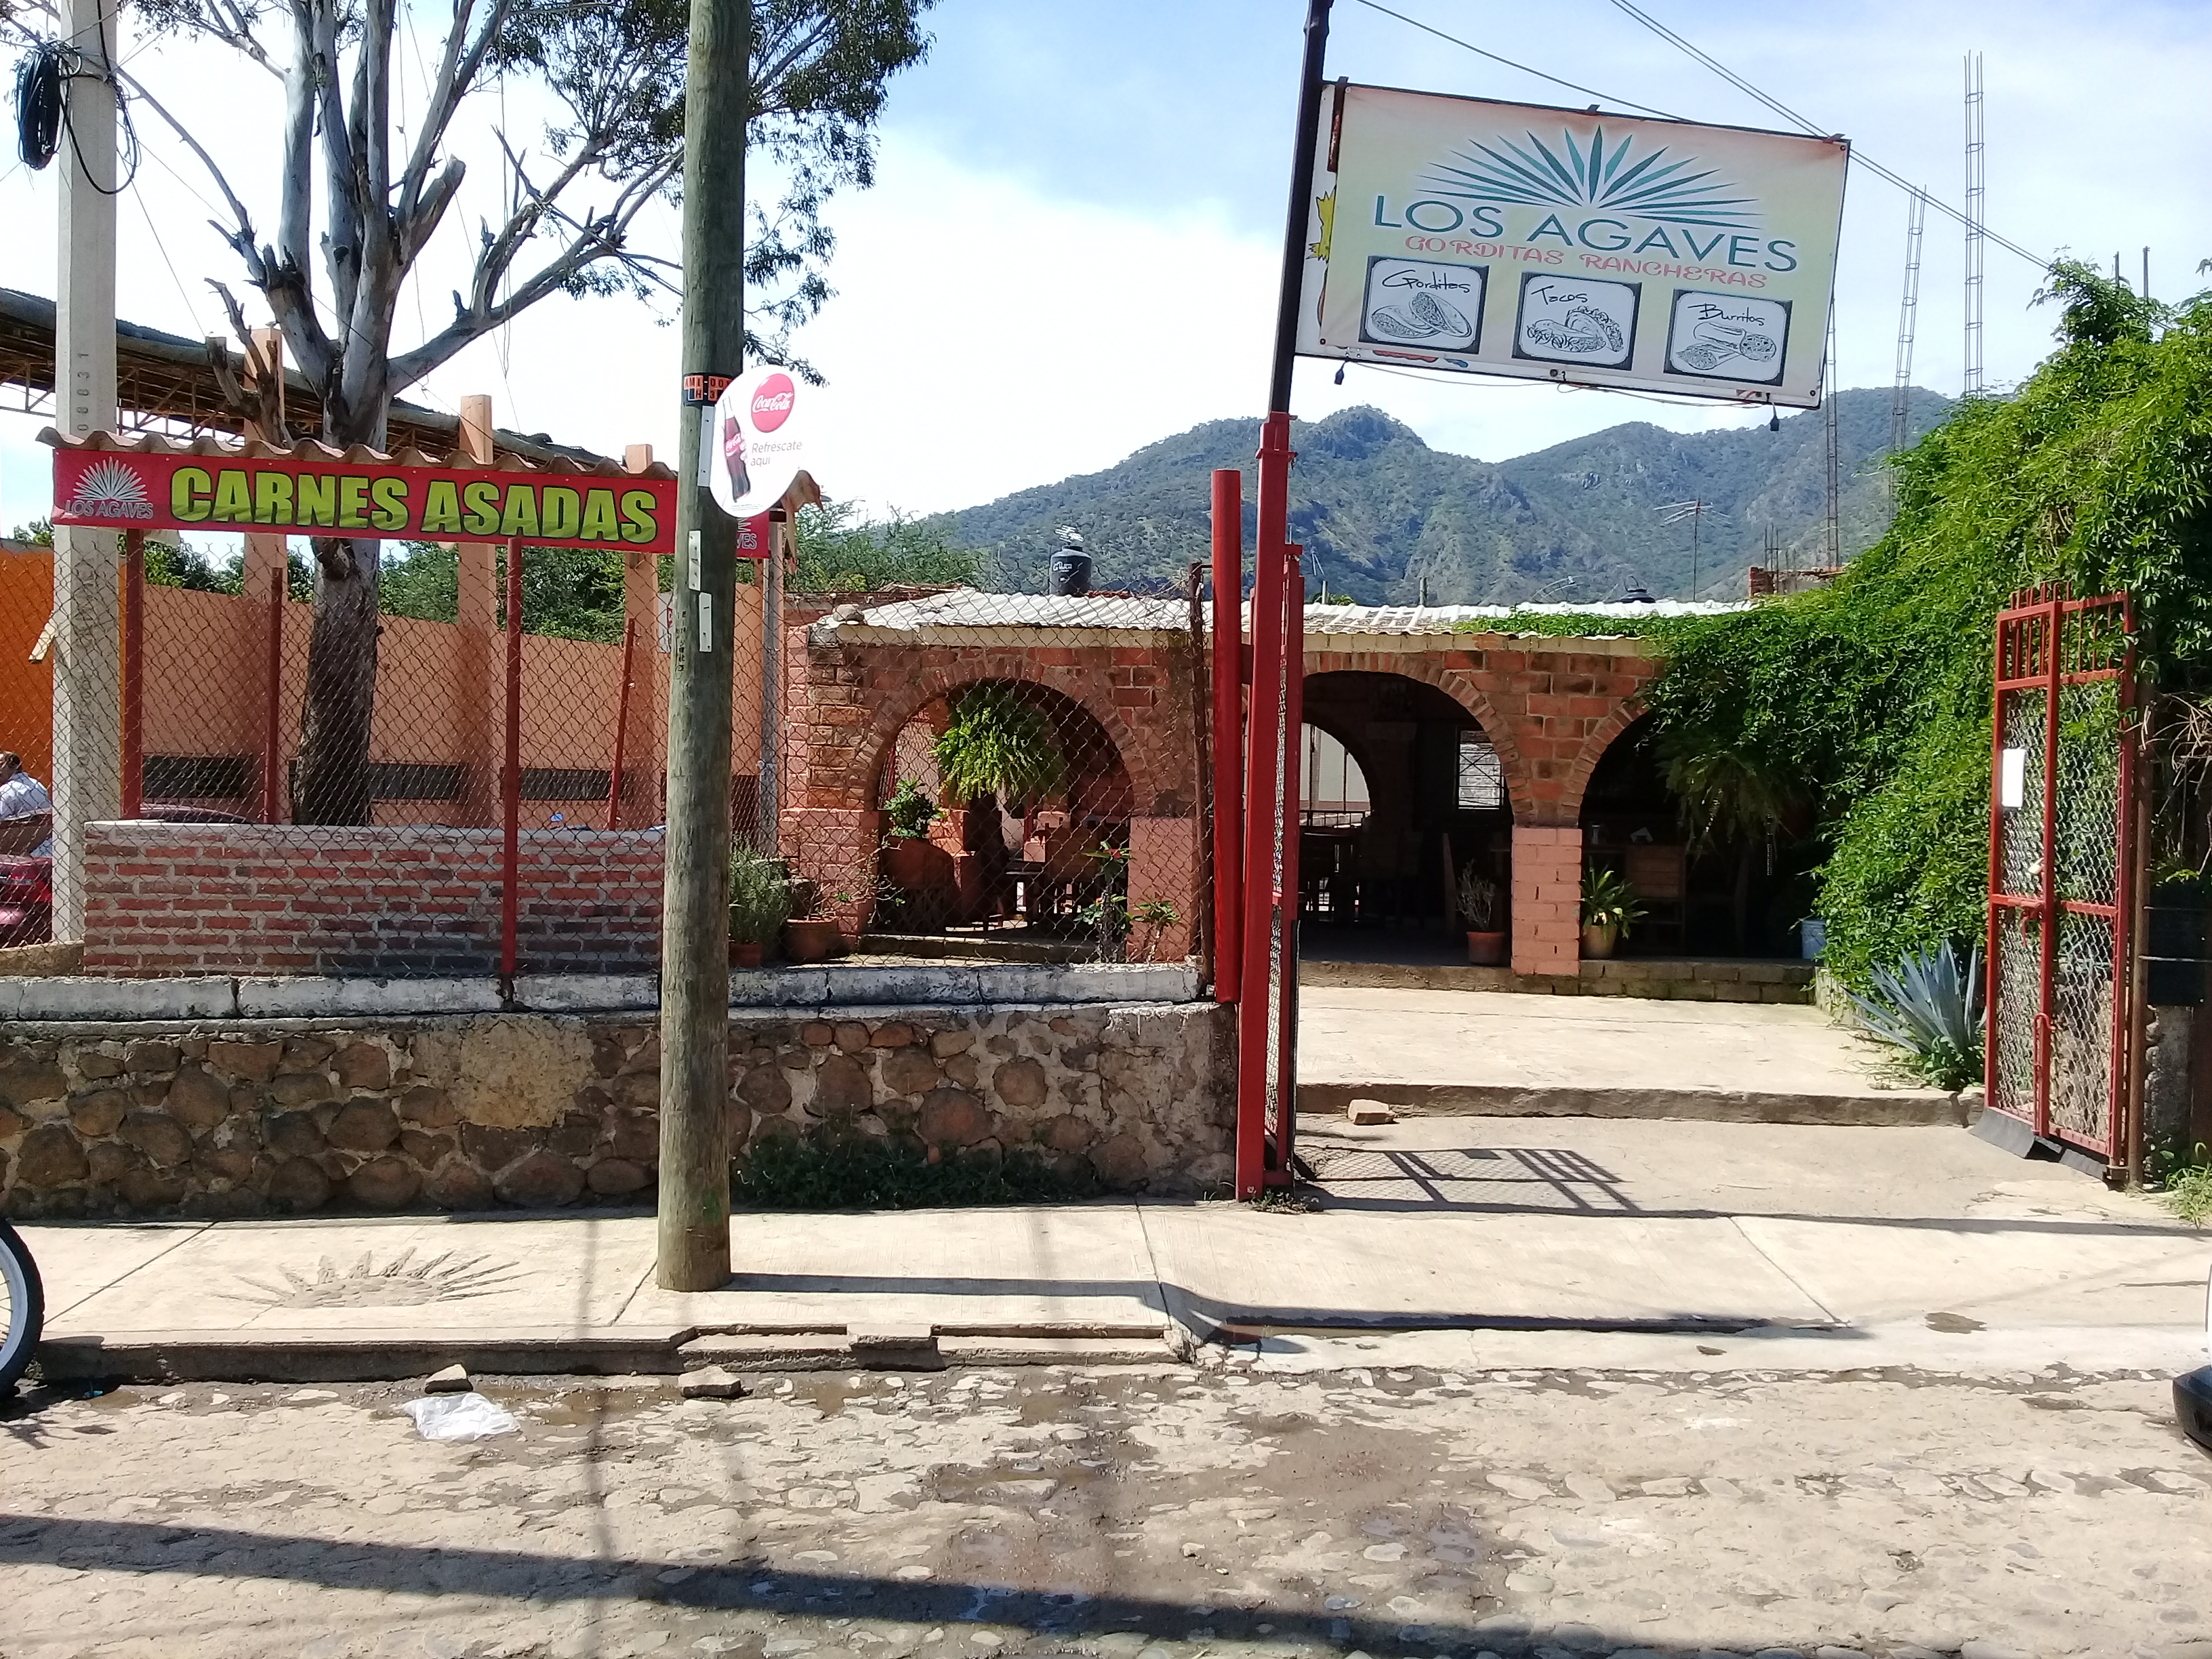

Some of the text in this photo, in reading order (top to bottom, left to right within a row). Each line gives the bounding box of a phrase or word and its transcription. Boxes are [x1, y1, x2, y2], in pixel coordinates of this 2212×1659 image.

[1374, 195, 1797, 272] LOS AGAVES
[1405, 236, 1768, 289] GORDITAS RANCHERAS
[1382, 269, 1471, 293] Gorditas
[1530, 285, 1588, 305] Tacos
[1687, 303, 1765, 326] Burritos
[65, 499, 154, 519] LOS AGAVES
[171, 466, 658, 544] CARNES ASADAS
